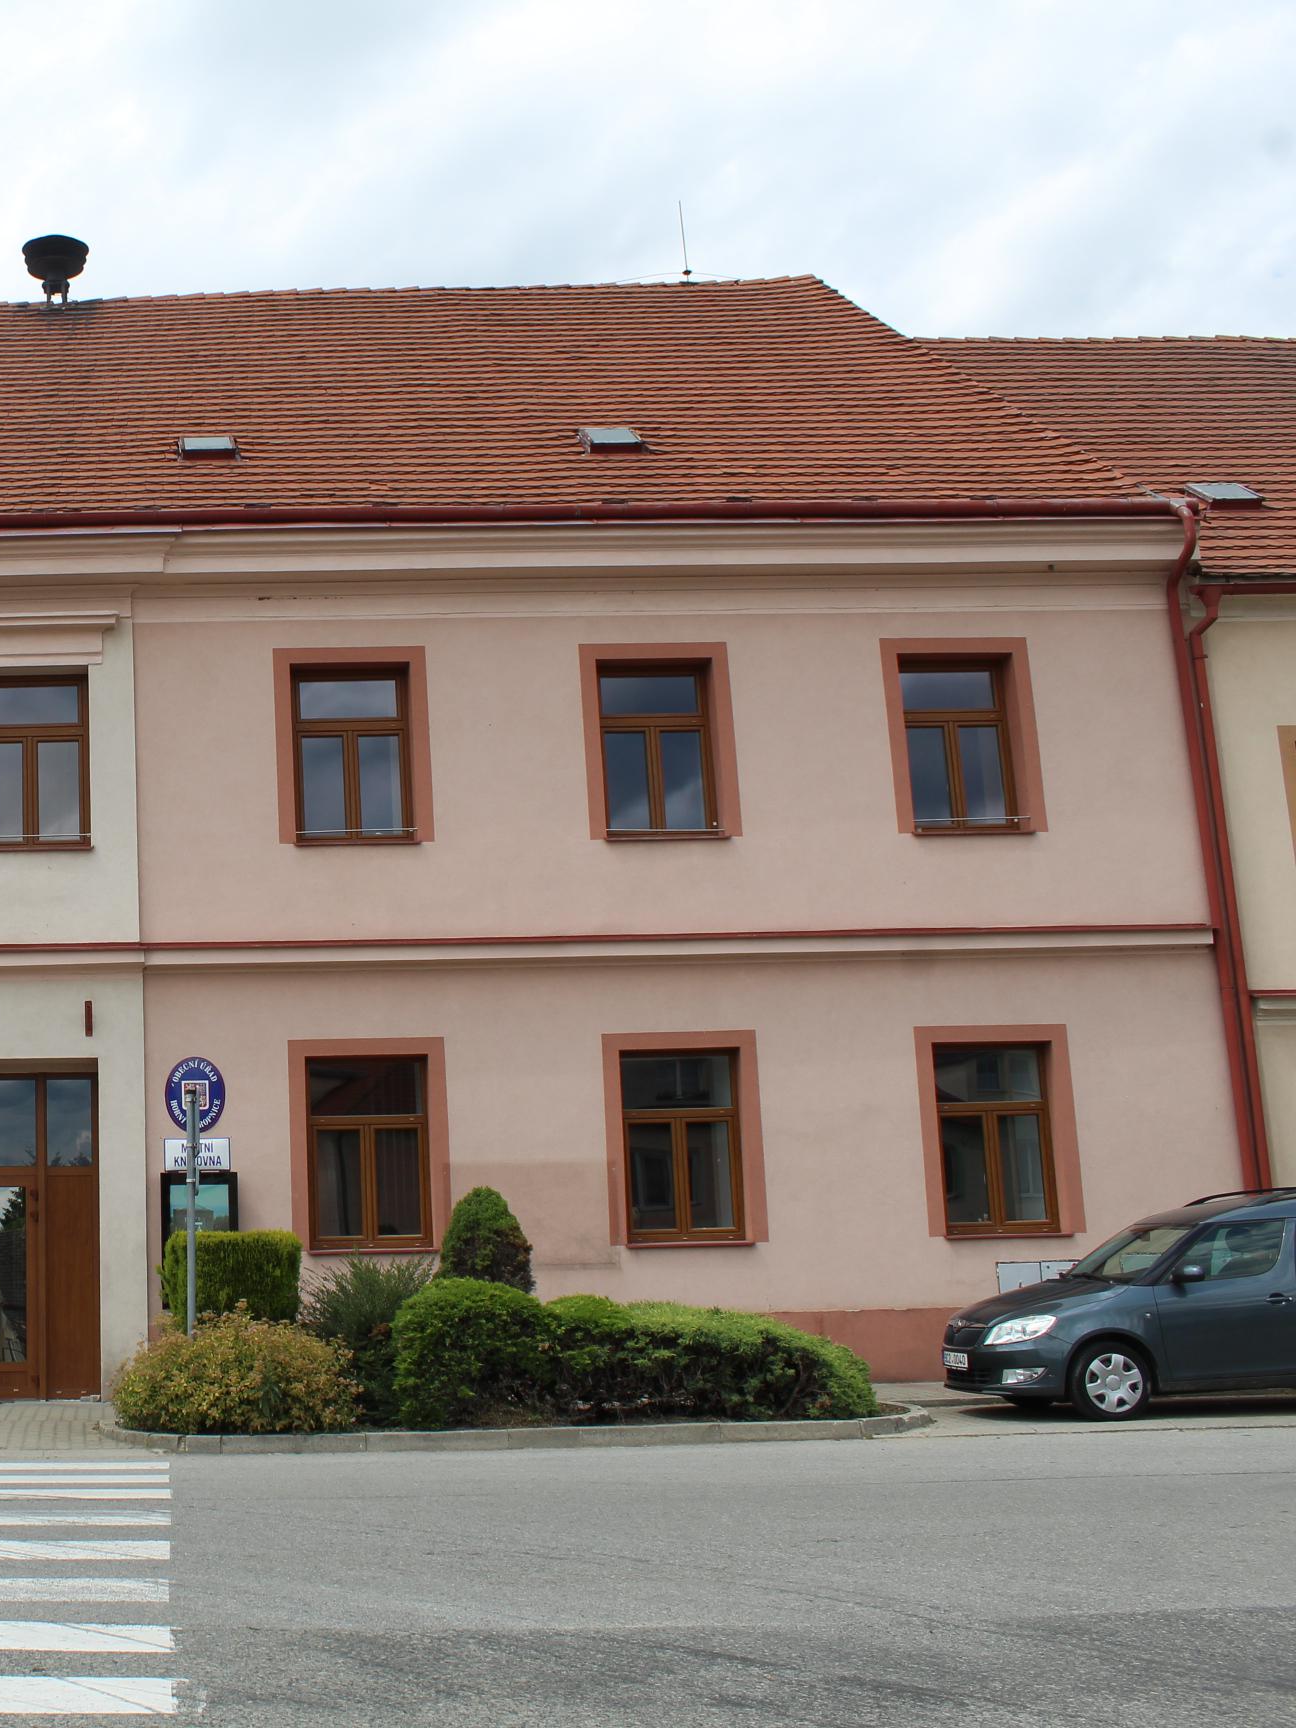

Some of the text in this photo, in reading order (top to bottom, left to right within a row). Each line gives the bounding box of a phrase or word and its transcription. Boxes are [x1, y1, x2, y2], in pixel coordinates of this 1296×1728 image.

[171, 1059, 218, 1083] OBECNÍ ÚŘAD
[173, 1155, 222, 1167] KNOVNA
